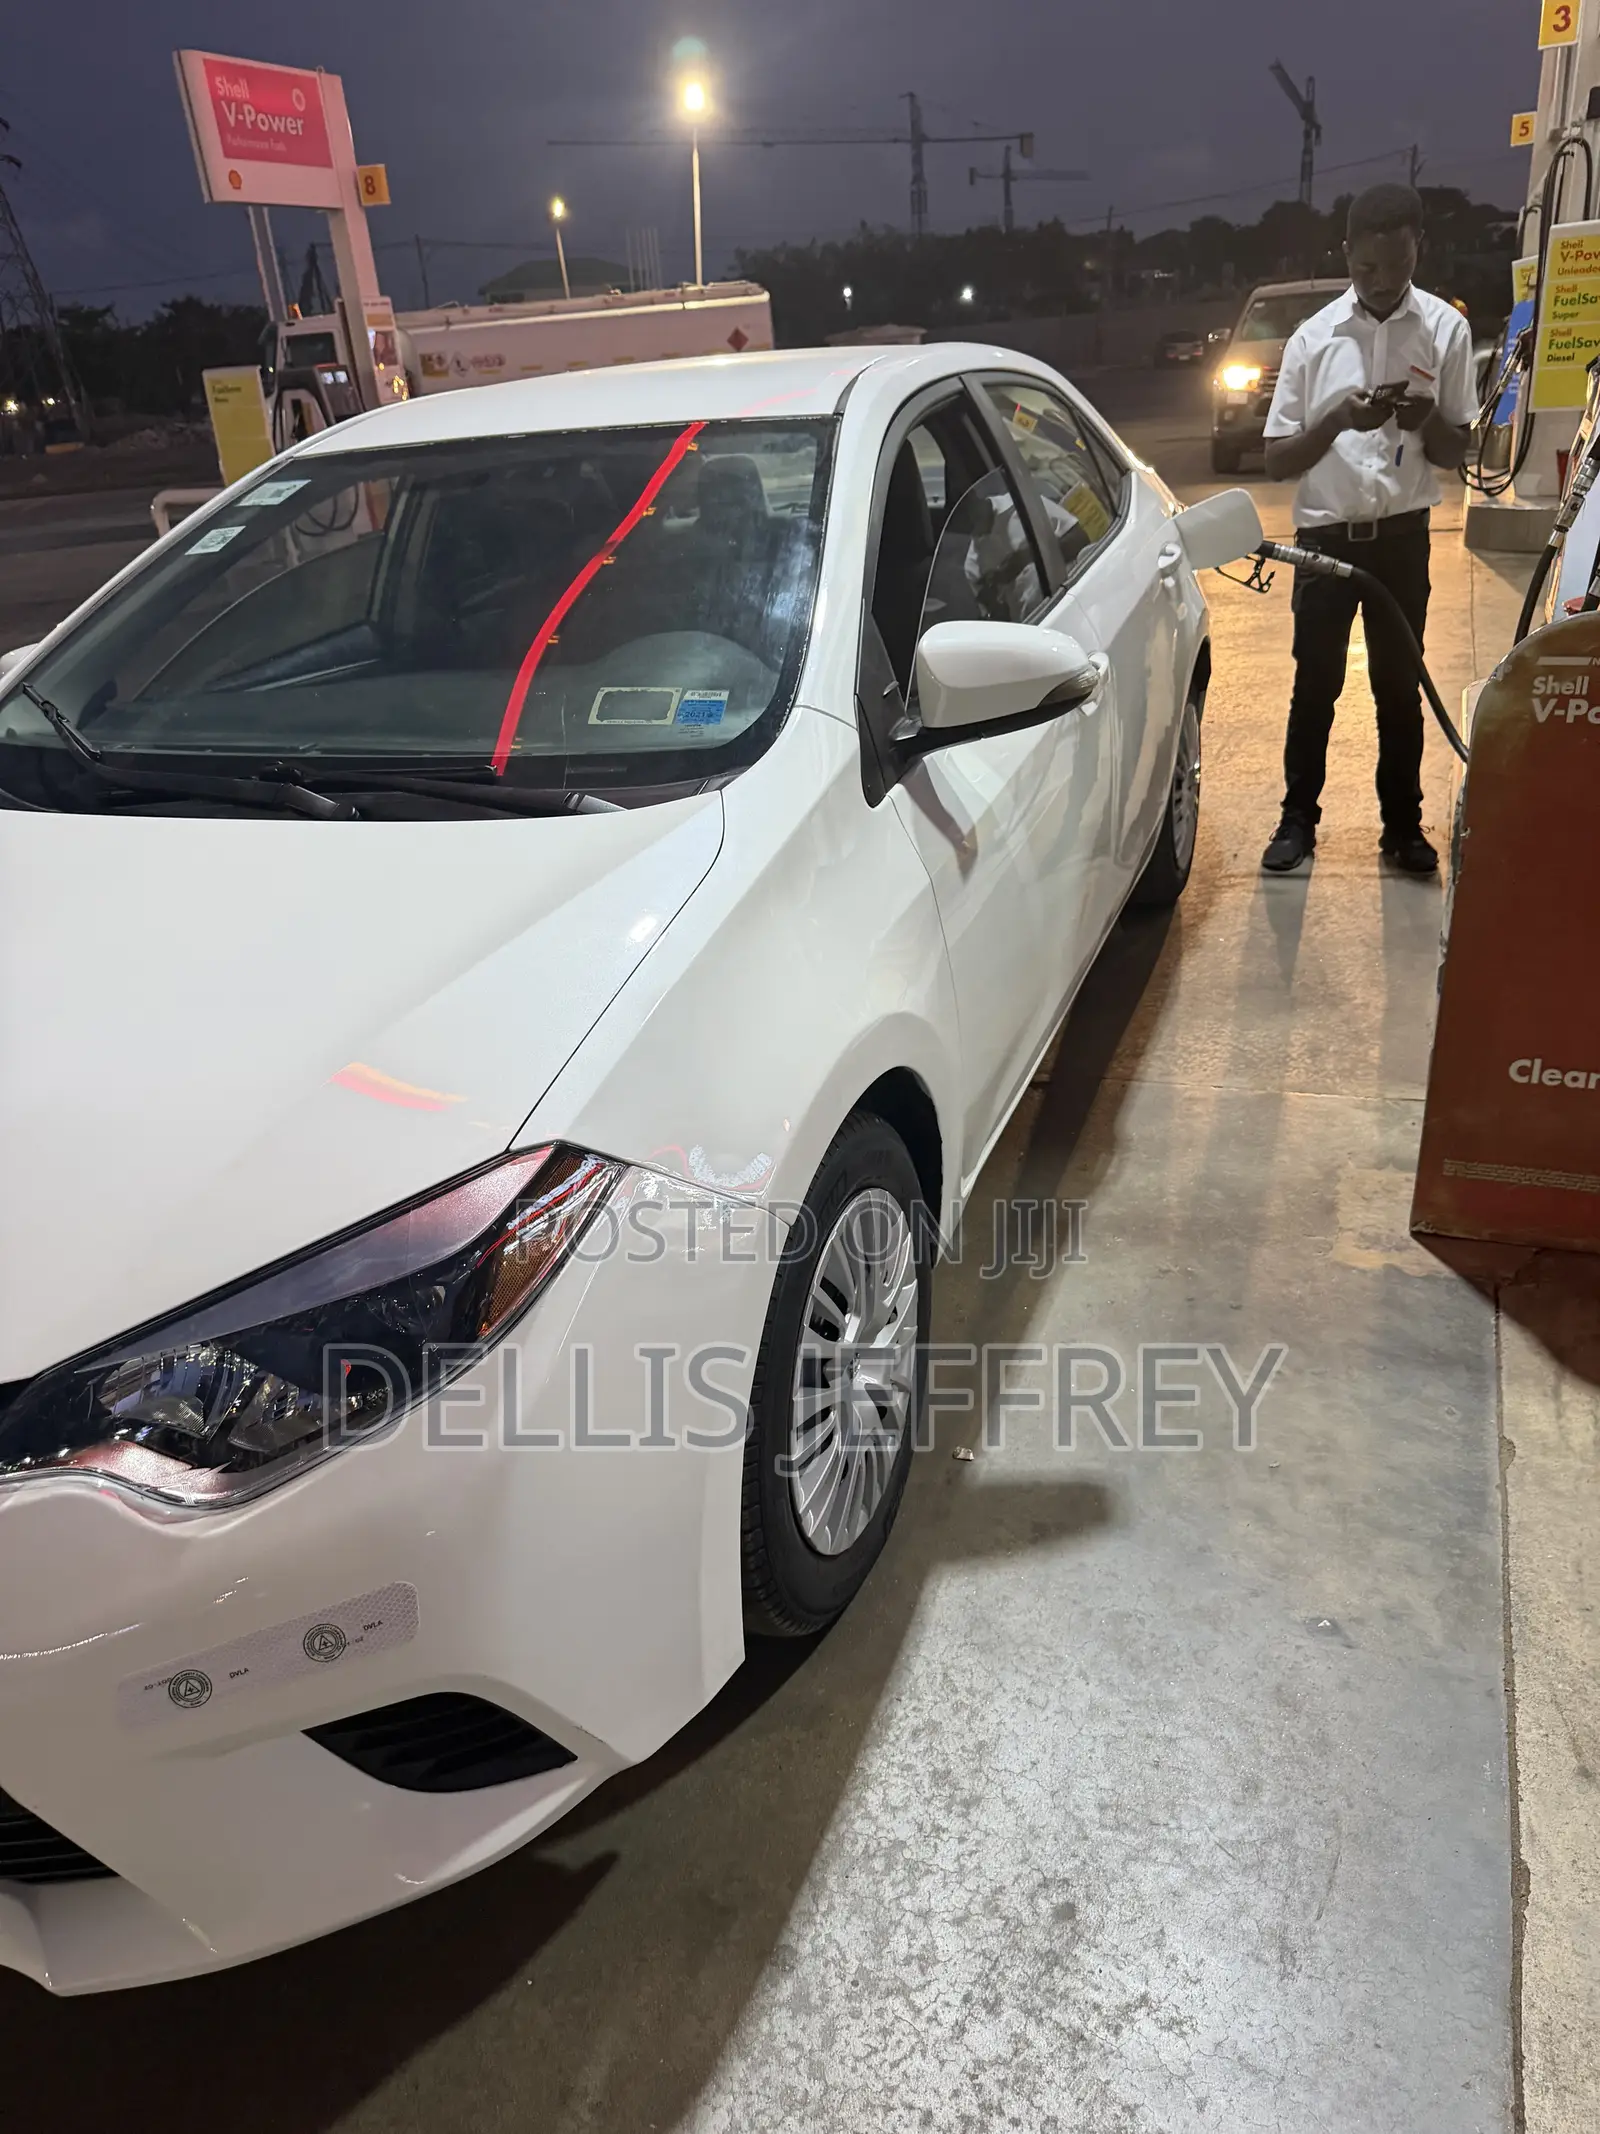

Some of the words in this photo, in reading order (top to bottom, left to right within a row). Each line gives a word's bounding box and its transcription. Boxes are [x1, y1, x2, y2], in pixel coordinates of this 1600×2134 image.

[1552, 5, 1571, 32] 3
[215, 76, 250, 99] Shell
[220, 100, 304, 136] V-Power
[1519, 121, 1530, 137] 5
[364, 175, 376, 196] 8
[1561, 239, 1584, 250] Shell
[1556, 284, 1578, 294] Shell
[1554, 293, 1600, 307] FuelSa
[1552, 311, 1580, 321] Super
[1550, 328, 1572, 338] Shell
[1547, 353, 1575, 363] Diesel
[1532, 675, 1589, 696] Shell
[363, 1620, 383, 1631] DVLA
[229, 1667, 249, 1679] DVLA
